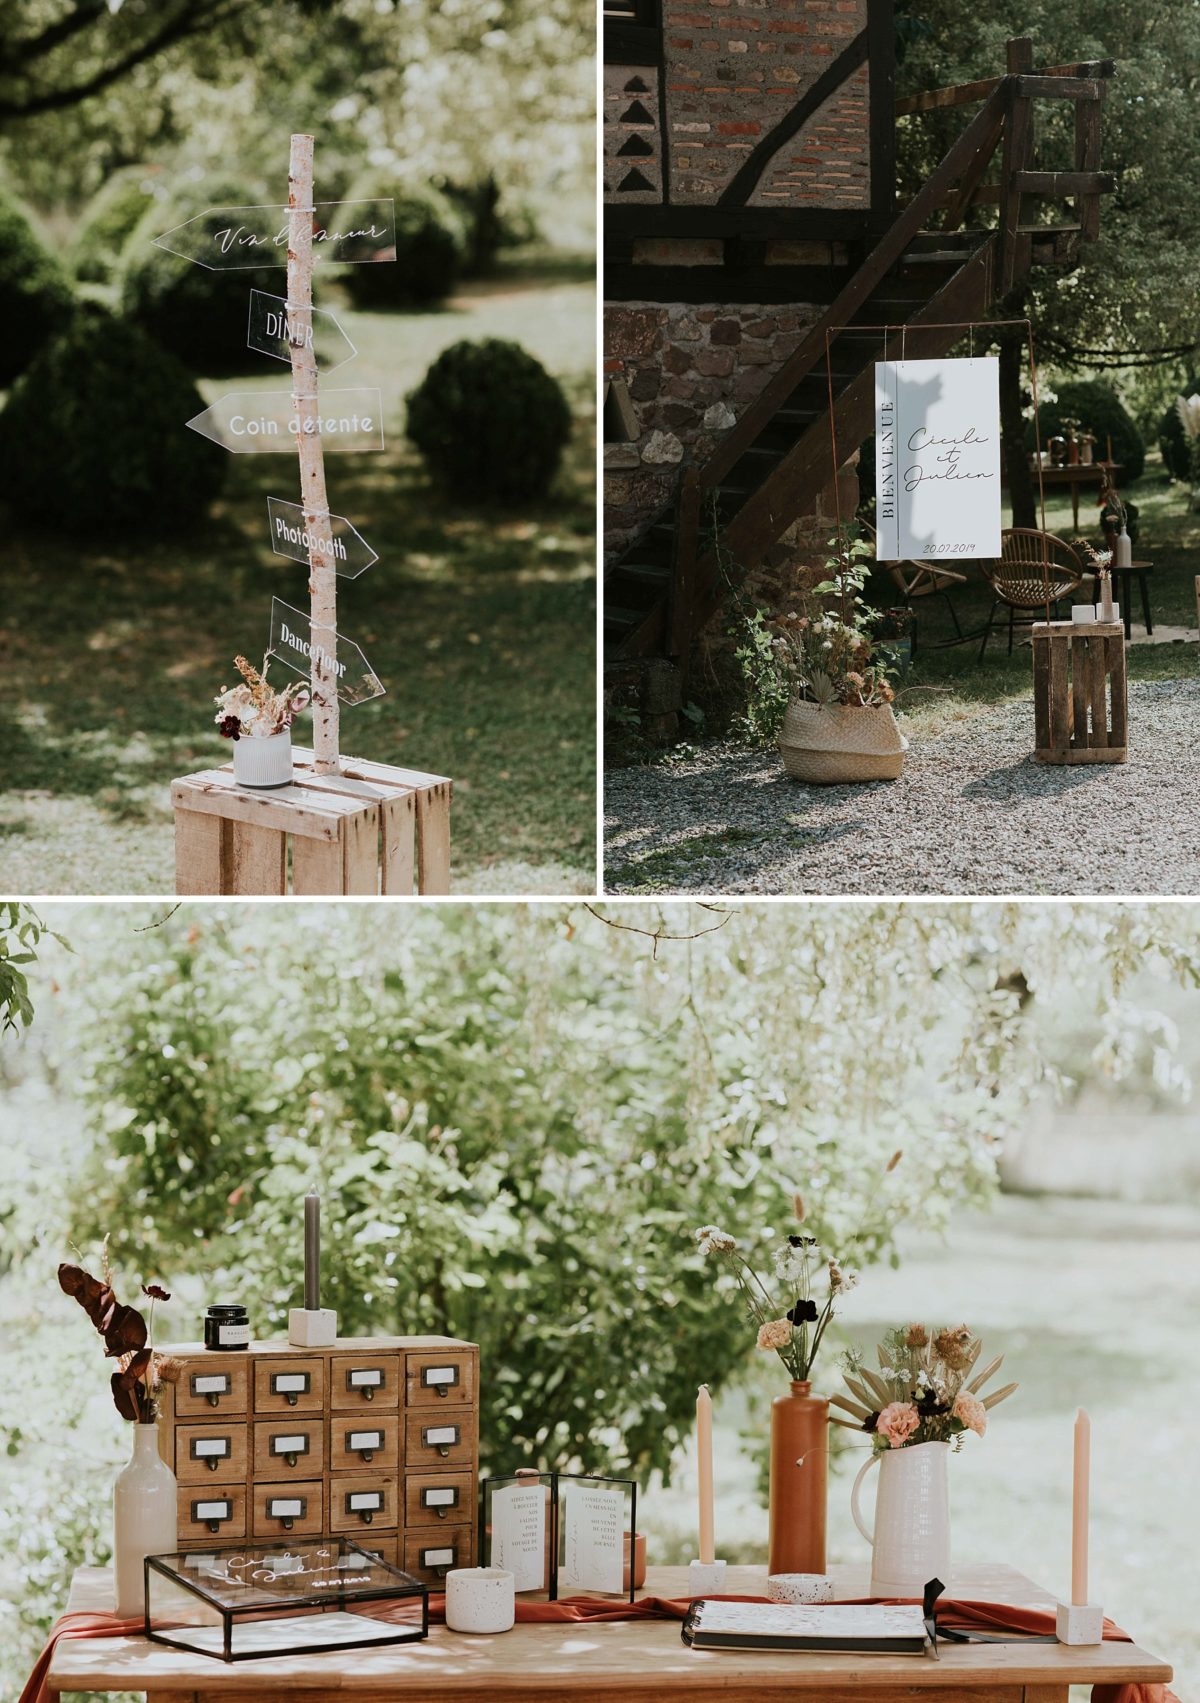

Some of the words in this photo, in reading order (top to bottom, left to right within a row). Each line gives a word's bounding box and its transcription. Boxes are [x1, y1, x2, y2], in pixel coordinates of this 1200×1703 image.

[214, 226, 268, 254] Vin
[272, 225, 387, 247] dhonneur
[266, 312, 314, 349] DÎNER
[229, 415, 278, 436] Coin
[288, 414, 374, 434] détente
[881, 402, 894, 519] BIENVENUE
[936, 446, 961, 464] et
[903, 463, 994, 492] Julien
[275, 518, 347, 561] Photobooth
[922, 543, 976, 554] 20.07.2019
[280, 622, 347, 679] Dancefloor
